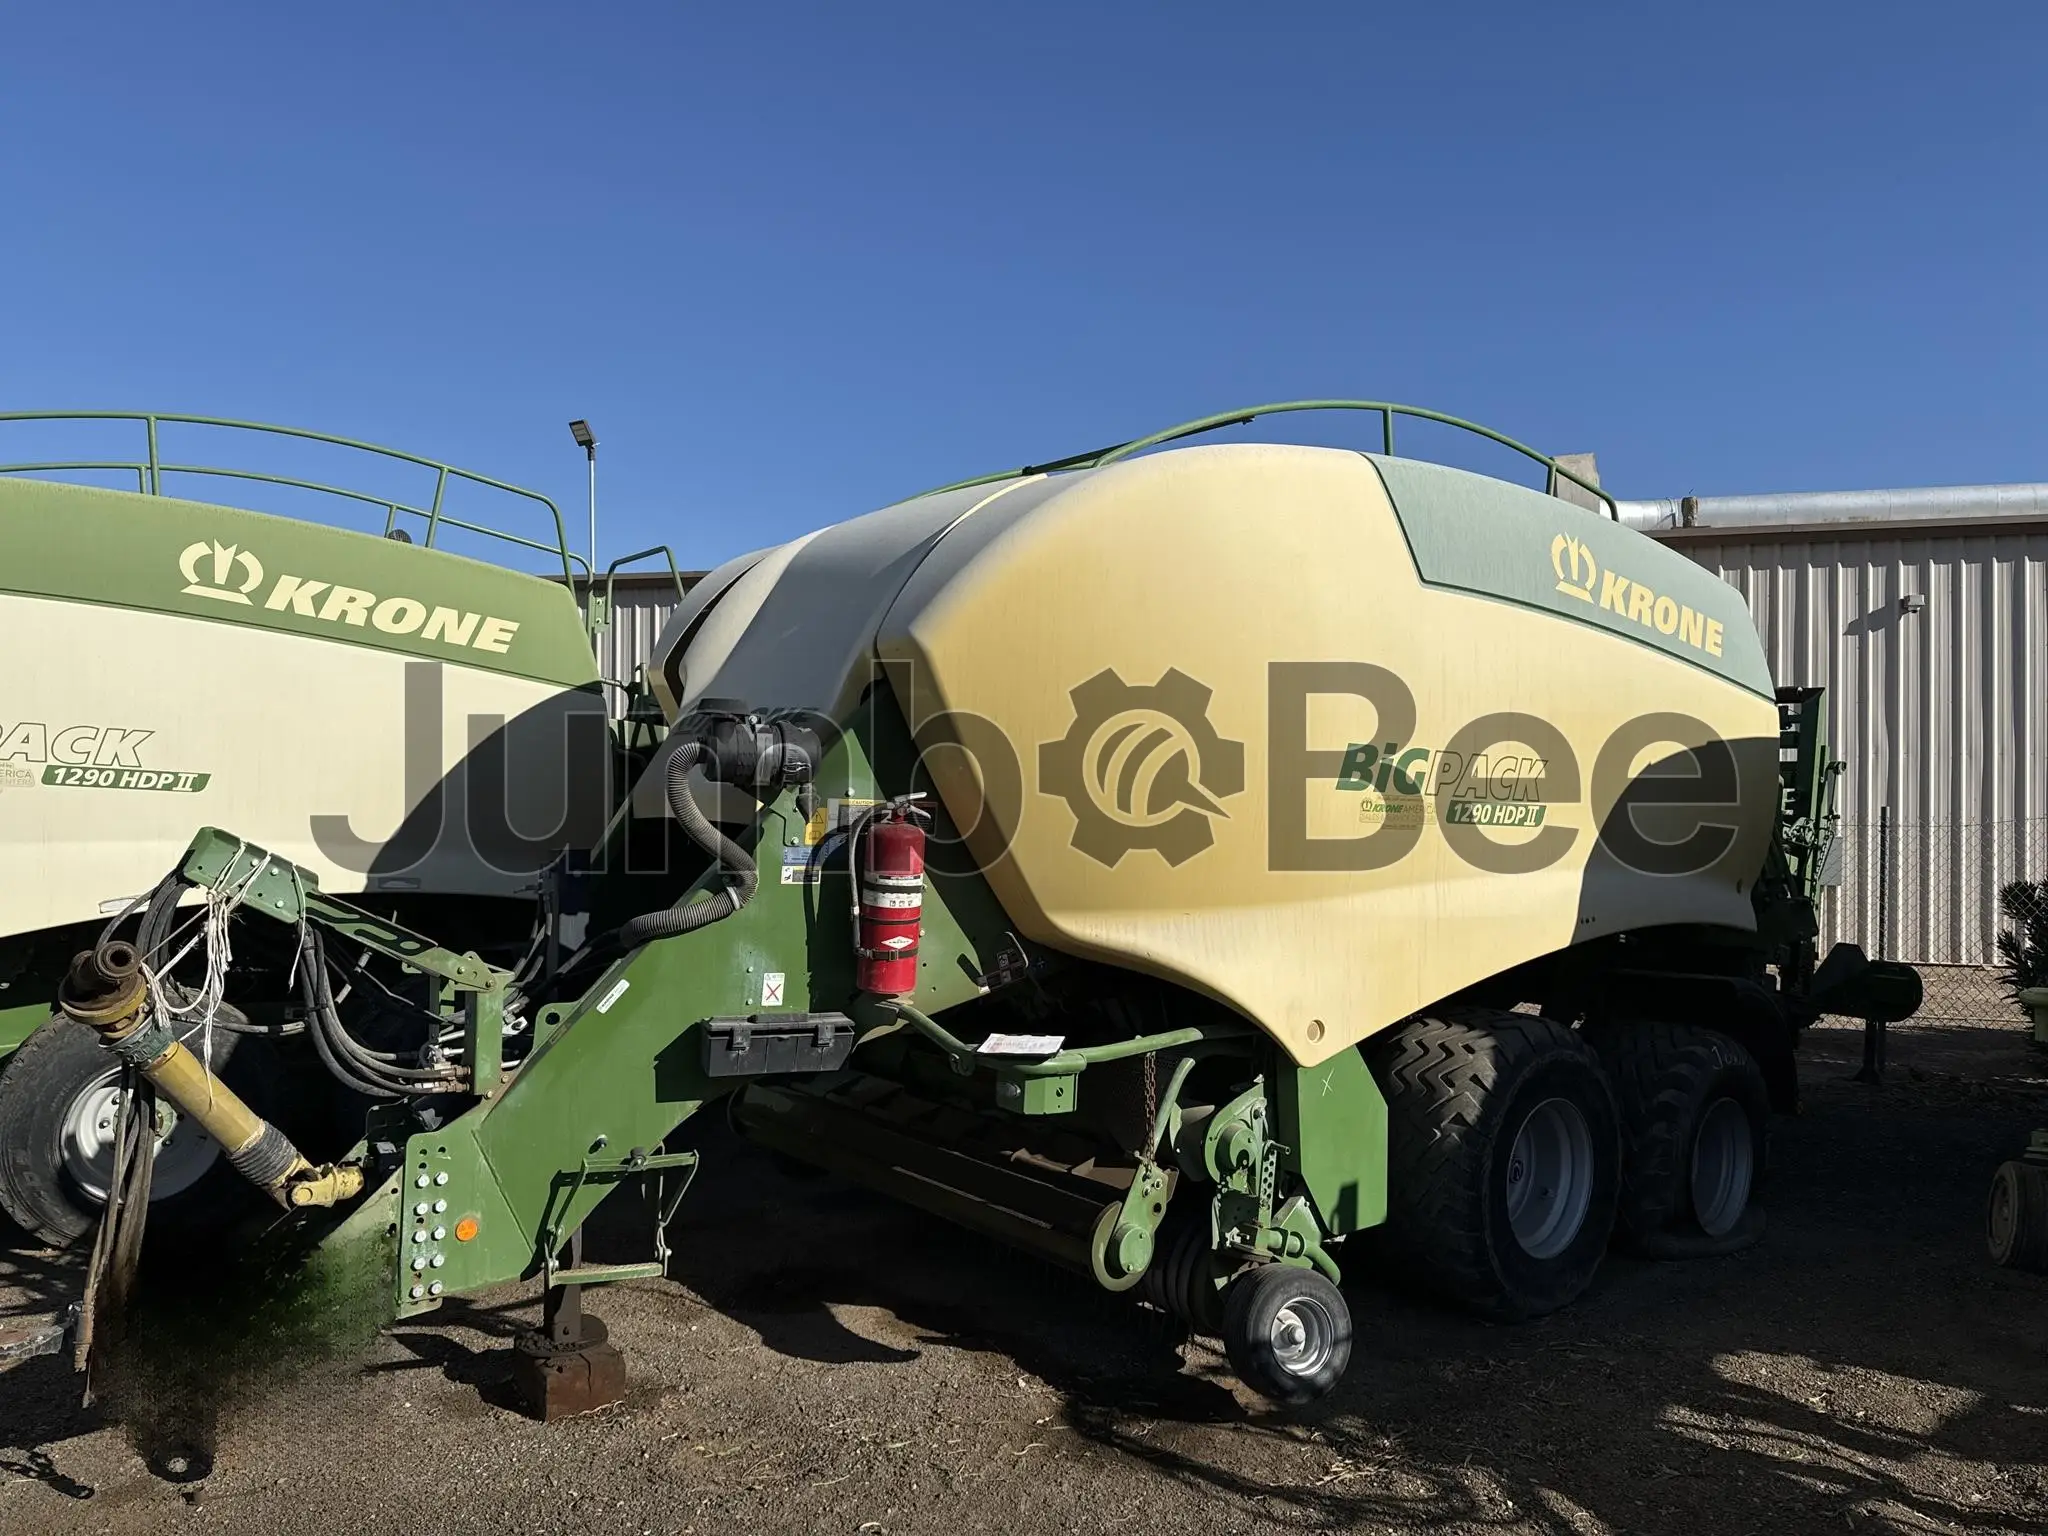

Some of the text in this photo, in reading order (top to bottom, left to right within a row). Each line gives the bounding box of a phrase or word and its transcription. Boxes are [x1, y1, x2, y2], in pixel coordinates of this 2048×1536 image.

[264, 574, 520, 654] KRONE
[1600, 569, 1723, 658] KRONE
[0, 722, 156, 768] ACK
[54, 768, 115, 787] 1290
[1453, 803, 1490, 824] 1290
